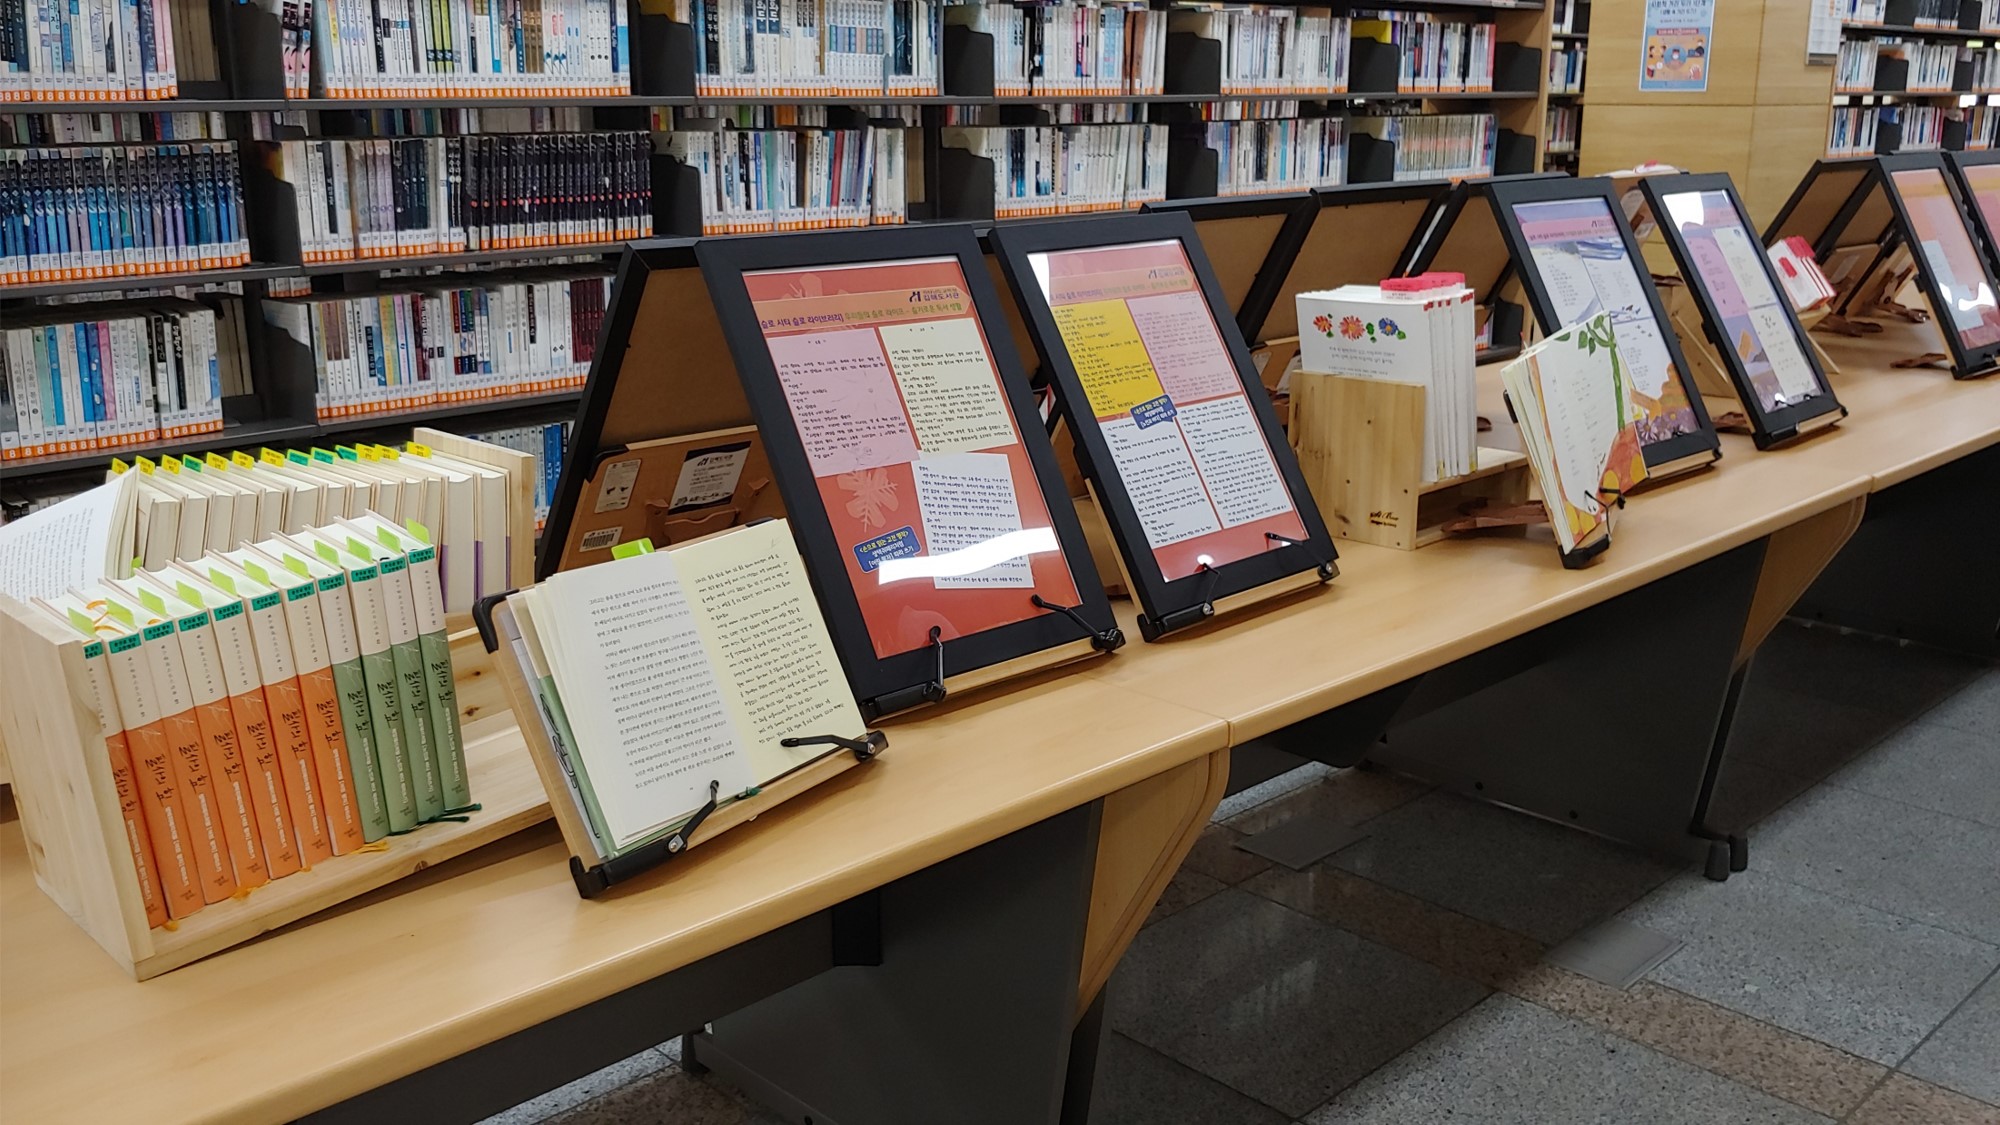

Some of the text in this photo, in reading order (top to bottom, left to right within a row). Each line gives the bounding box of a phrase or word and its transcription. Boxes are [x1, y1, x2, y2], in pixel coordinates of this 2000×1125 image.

[24, 91, 30, 100] 8
[69, 91, 75, 100] 8
[79, 91, 85, 100] 8
[99, 91, 106, 100] 8
[130, 91, 136, 99] 8
[138, 91, 144, 99] 8
[151, 90, 157, 99] 8
[162, 89, 168, 97] 8
[171, 87, 177, 95] 8
[5, 92, 11, 101] 8
[14, 92, 20, 100] 8
[37, 91, 43, 101] 8
[47, 92, 54, 101] 8
[58, 92, 64, 101] 8
[89, 92, 95, 101] 8
[111, 92, 117, 101] 8
[119, 92, 126, 101] 8
[226, 258, 232, 266] 8
[236, 257, 241, 265] 8
[244, 254, 249, 262] 8
[159, 263, 165, 272] 8
[171, 262, 176, 271] 8
[182, 261, 188, 270] 8
[193, 261, 199, 269] 8
[205, 259, 211, 267] 8
[215, 259, 220, 267] 8
[86, 268, 92, 277] 8
[96, 267, 103, 276] 8
[106, 267, 113, 275] 8
[118, 266, 124, 275] 8
[129, 264, 135, 273] 8
[139, 265, 145, 273] 8
[149, 264, 155, 273] 8
[12, 273, 18, 282] 8
[22, 273, 28, 282] 8
[34, 272, 39, 280] 8
[43, 271, 50, 280] 8
[54, 271, 61, 279] 8
[65, 270, 71, 279] 8
[76, 269, 82, 278] 8
[1, 275, 6, 284] 8
[761, 320, 775, 329] 슬로
[777, 318, 791, 327] 시티
[792, 316, 806, 326] 슬로
[807, 313, 844, 324] 라이브러리]
[911, 305, 935, 315] 슬기로운
[191, 425, 196, 433] 8
[200, 424, 206, 432] 8
[209, 423, 214, 431] 8
[149, 431, 155, 440] 8
[165, 430, 171, 438] 8
[174, 428, 179, 436] 8
[112, 437, 118, 445] 8
[122, 436, 127, 444] 8
[139, 433, 145, 441] 8
[70, 442, 77, 450] 8
[81, 441, 87, 449] 8
[90, 440, 96, 448] 8
[102, 438, 107, 446] 8
[25, 448, 31, 456] 8
[37, 447, 43, 455] 8
[50, 444, 55, 452] 8
[60, 443, 66, 452] 8
[9, 450, 15, 458] 8
[859, 542, 876, 552] <손으로
[886, 534, 897, 542] 고전
[895, 530, 908, 540] 명작>
[893, 549, 904, 557] 따라
[904, 545, 914, 554] 쓰기
[431, 659, 449, 686] 필사의
[404, 671, 422, 698] 필사의
[377, 681, 396, 708] 필사의
[438, 690, 454, 708] 힘
[347, 689, 364, 718] 필사의
[411, 700, 426, 718] 힘
[282, 709, 301, 738] 필사의
[384, 710, 400, 728] 힘
[316, 699, 334, 728] 필사의
[325, 729, 342, 749] 힘
[355, 719, 370, 738] 힘
[246, 720, 266, 750] 필사의
[256, 752, 274, 772] 힘
[291, 741, 308, 760] 힘
[213, 729, 234, 760] 필사의
[224, 762, 242, 782] 힘
[145, 754, 166, 785] 필사의
[178, 741, 200, 772] 필사의
[189, 774, 208, 794] 힘
[155, 786, 174, 808] 힘
